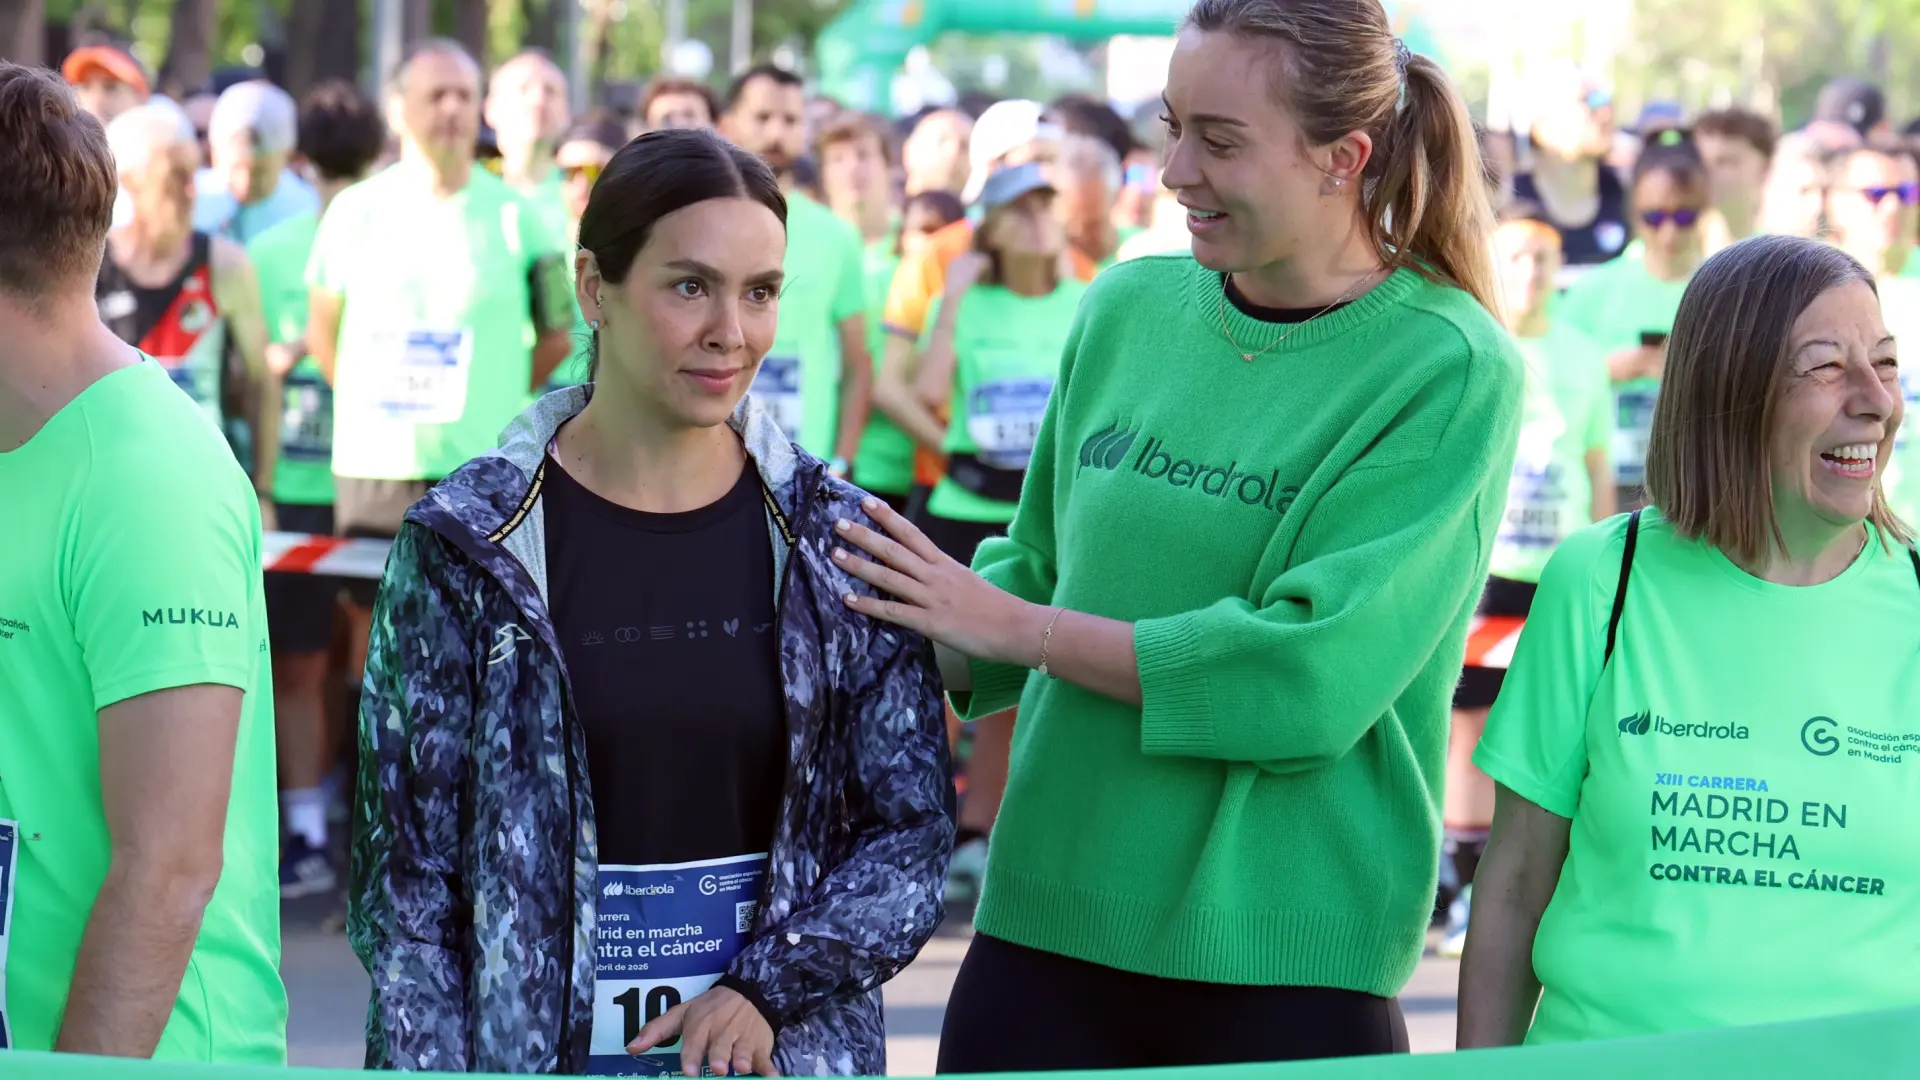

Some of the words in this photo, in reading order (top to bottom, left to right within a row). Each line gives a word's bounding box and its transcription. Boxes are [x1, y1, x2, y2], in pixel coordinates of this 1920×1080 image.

[1133, 436, 1301, 514] Iberdrola
[0, 617, 30, 632] pañola
[142, 608, 239, 629] MUKUA
[1654, 715, 1749, 740] Iberdrola
[1847, 725, 1900, 742] asociación
[1902, 732, 1920, 744] esp
[1847, 736, 1879, 750] contra
[1881, 743, 1891, 752] el
[1847, 748, 1862, 757] en
[1864, 749, 1902, 764] Madrid
[1654, 772, 1683, 786] XIII
[1687, 775, 1769, 793] CARRERA
[1650, 790, 1789, 824] MADRID
[1801, 801, 1848, 829] EN
[1651, 825, 1801, 861] MARCHA
[1649, 862, 1748, 886] CONTRA
[1753, 869, 1782, 888] EL
[1787, 868, 1886, 896] CÁNCER
[598, 913, 630, 921] arrera
[625, 929, 645, 939] en
[648, 923, 703, 939] marcha
[638, 941, 657, 957] el
[660, 938, 723, 957] cáncer
[614, 963, 627, 971] de
[627, 962, 649, 971] 2026
